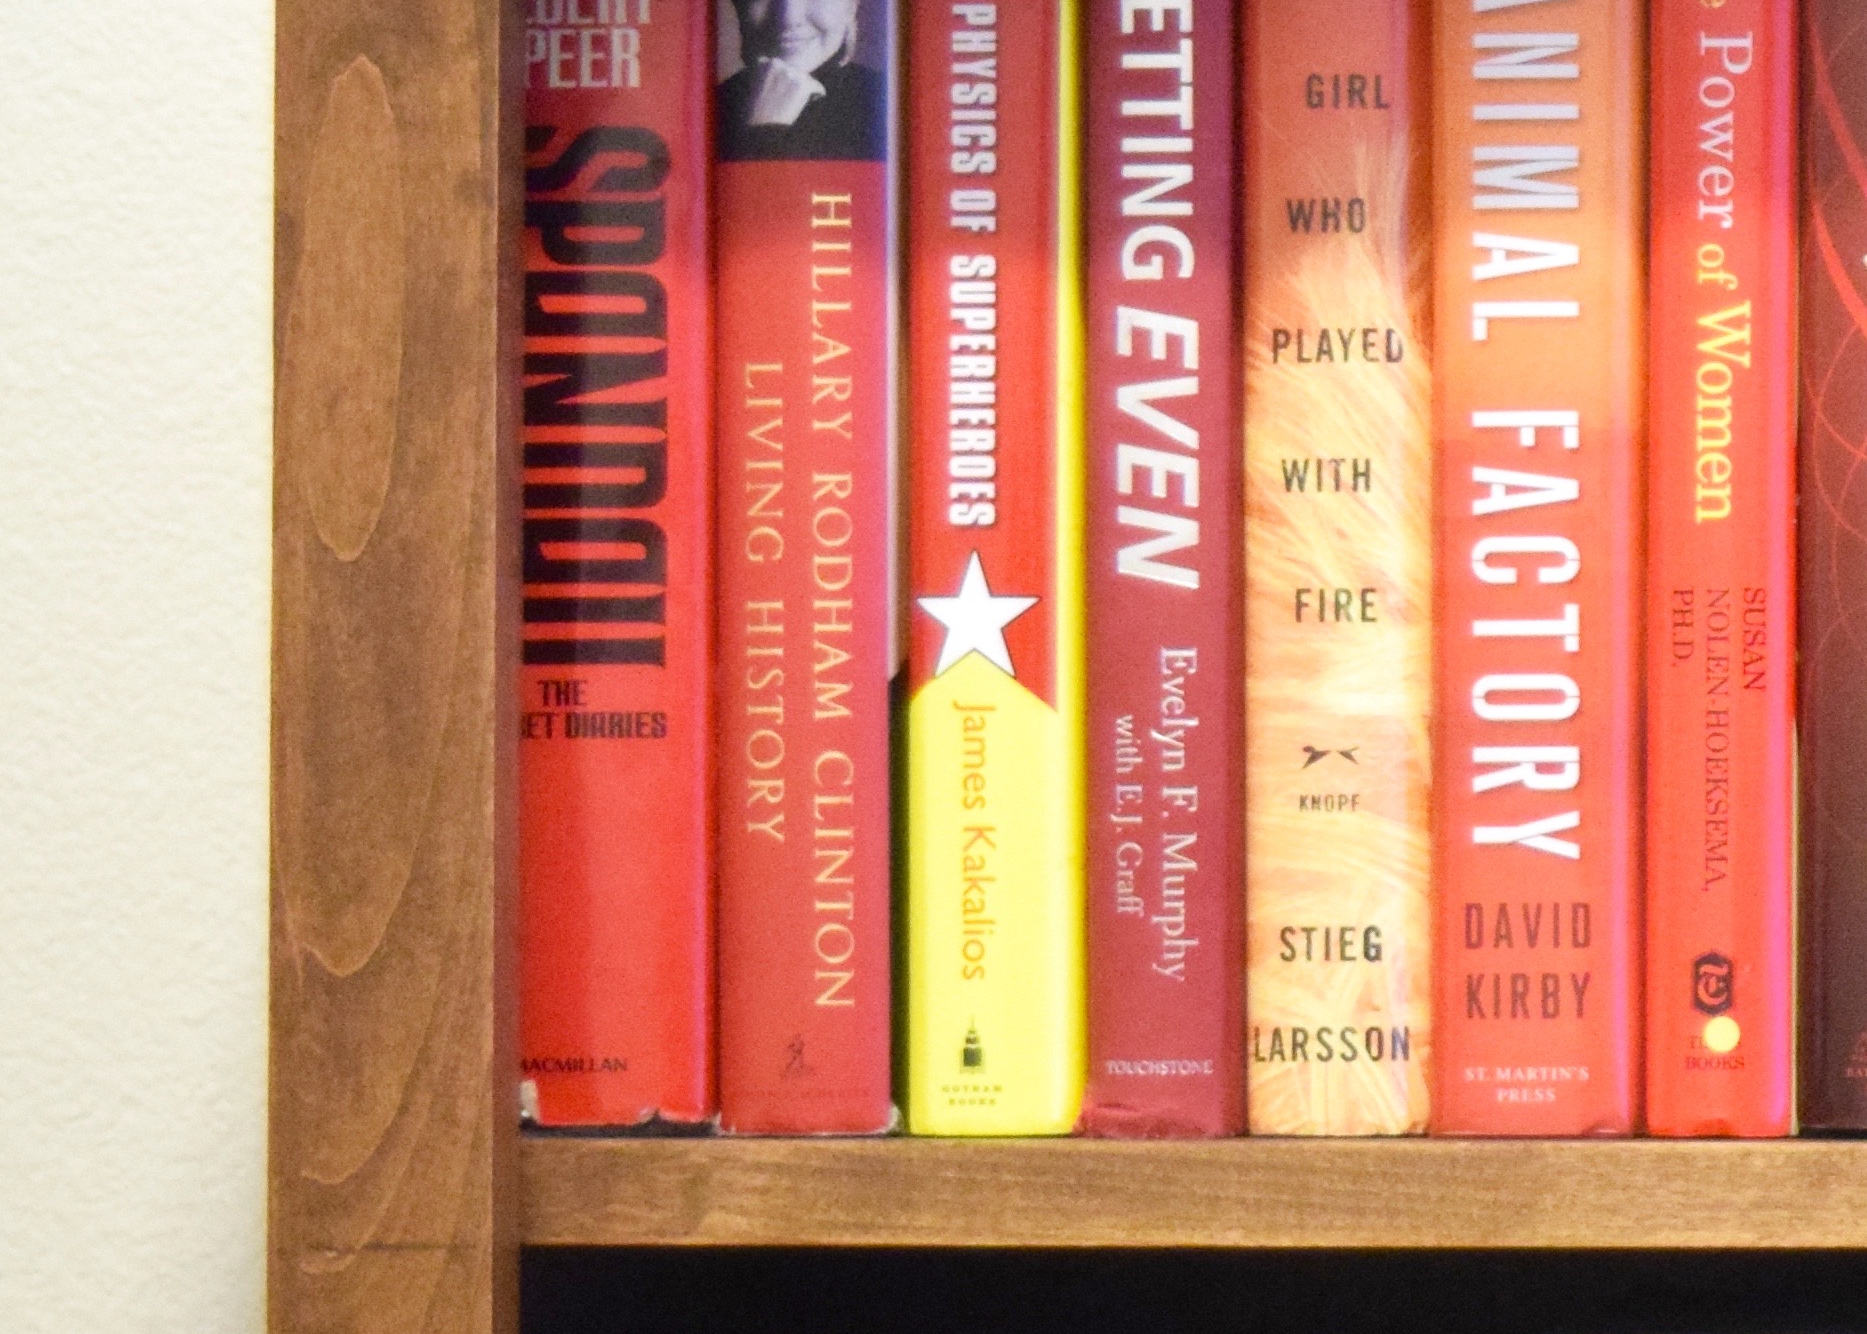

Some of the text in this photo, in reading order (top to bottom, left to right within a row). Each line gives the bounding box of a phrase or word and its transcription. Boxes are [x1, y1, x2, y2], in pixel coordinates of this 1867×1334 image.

[949, 0, 996, 177] PHYSICS
[949, 187, 996, 236] OF
[946, 254, 998, 530] SUPERHEROES
[1117, 307, 1199, 587] EVEN
[745, 363, 785, 842] LIVING HISTORY
[812, 192, 854, 1010] HILLARY RODHAM CLINTON
[1470, 410, 1582, 863] FACTORY
[949, 698, 997, 983] James Kakalios
